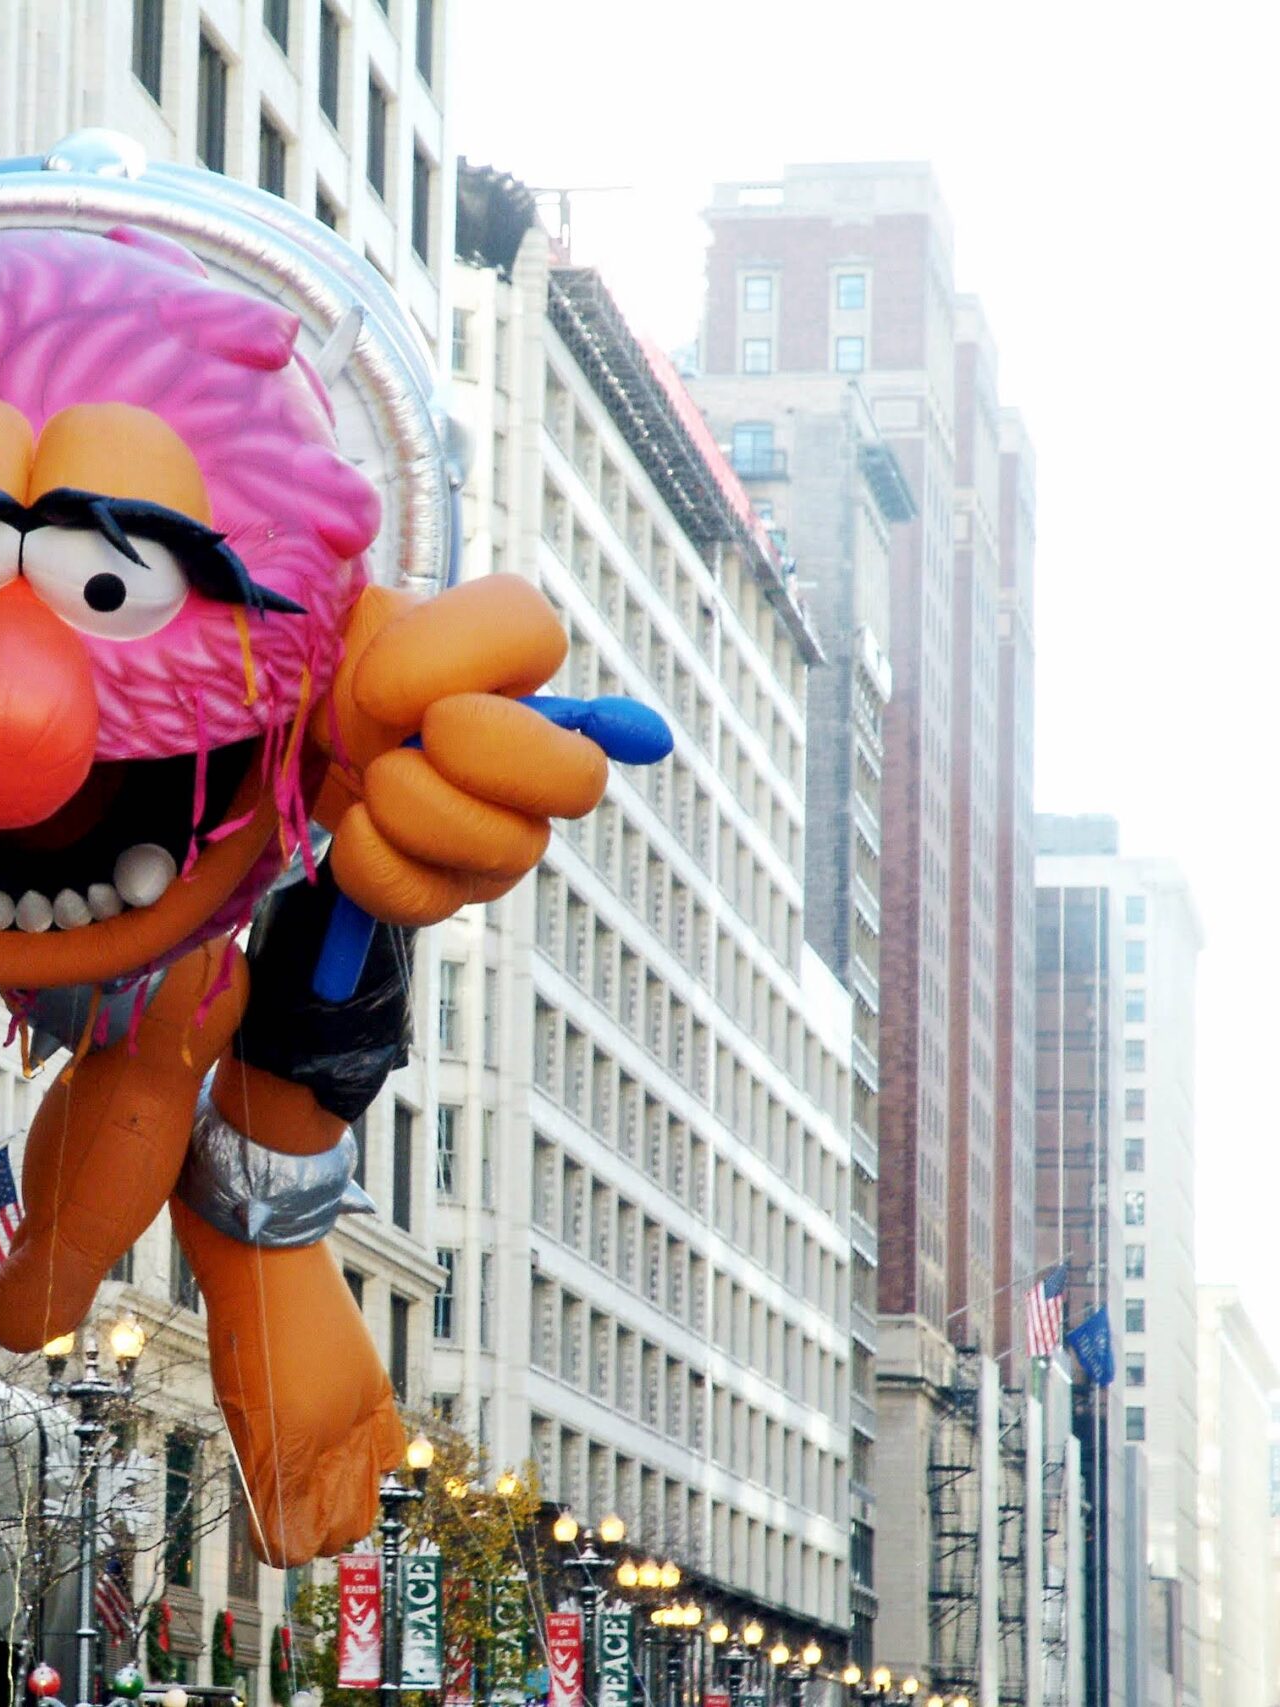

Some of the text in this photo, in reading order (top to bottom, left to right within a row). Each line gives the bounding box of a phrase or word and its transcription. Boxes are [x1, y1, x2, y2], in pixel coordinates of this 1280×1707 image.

[343, 1585, 377, 1595] EARTH
[407, 1561, 437, 1670] PEACE
[602, 1618, 629, 1707] PEACE
